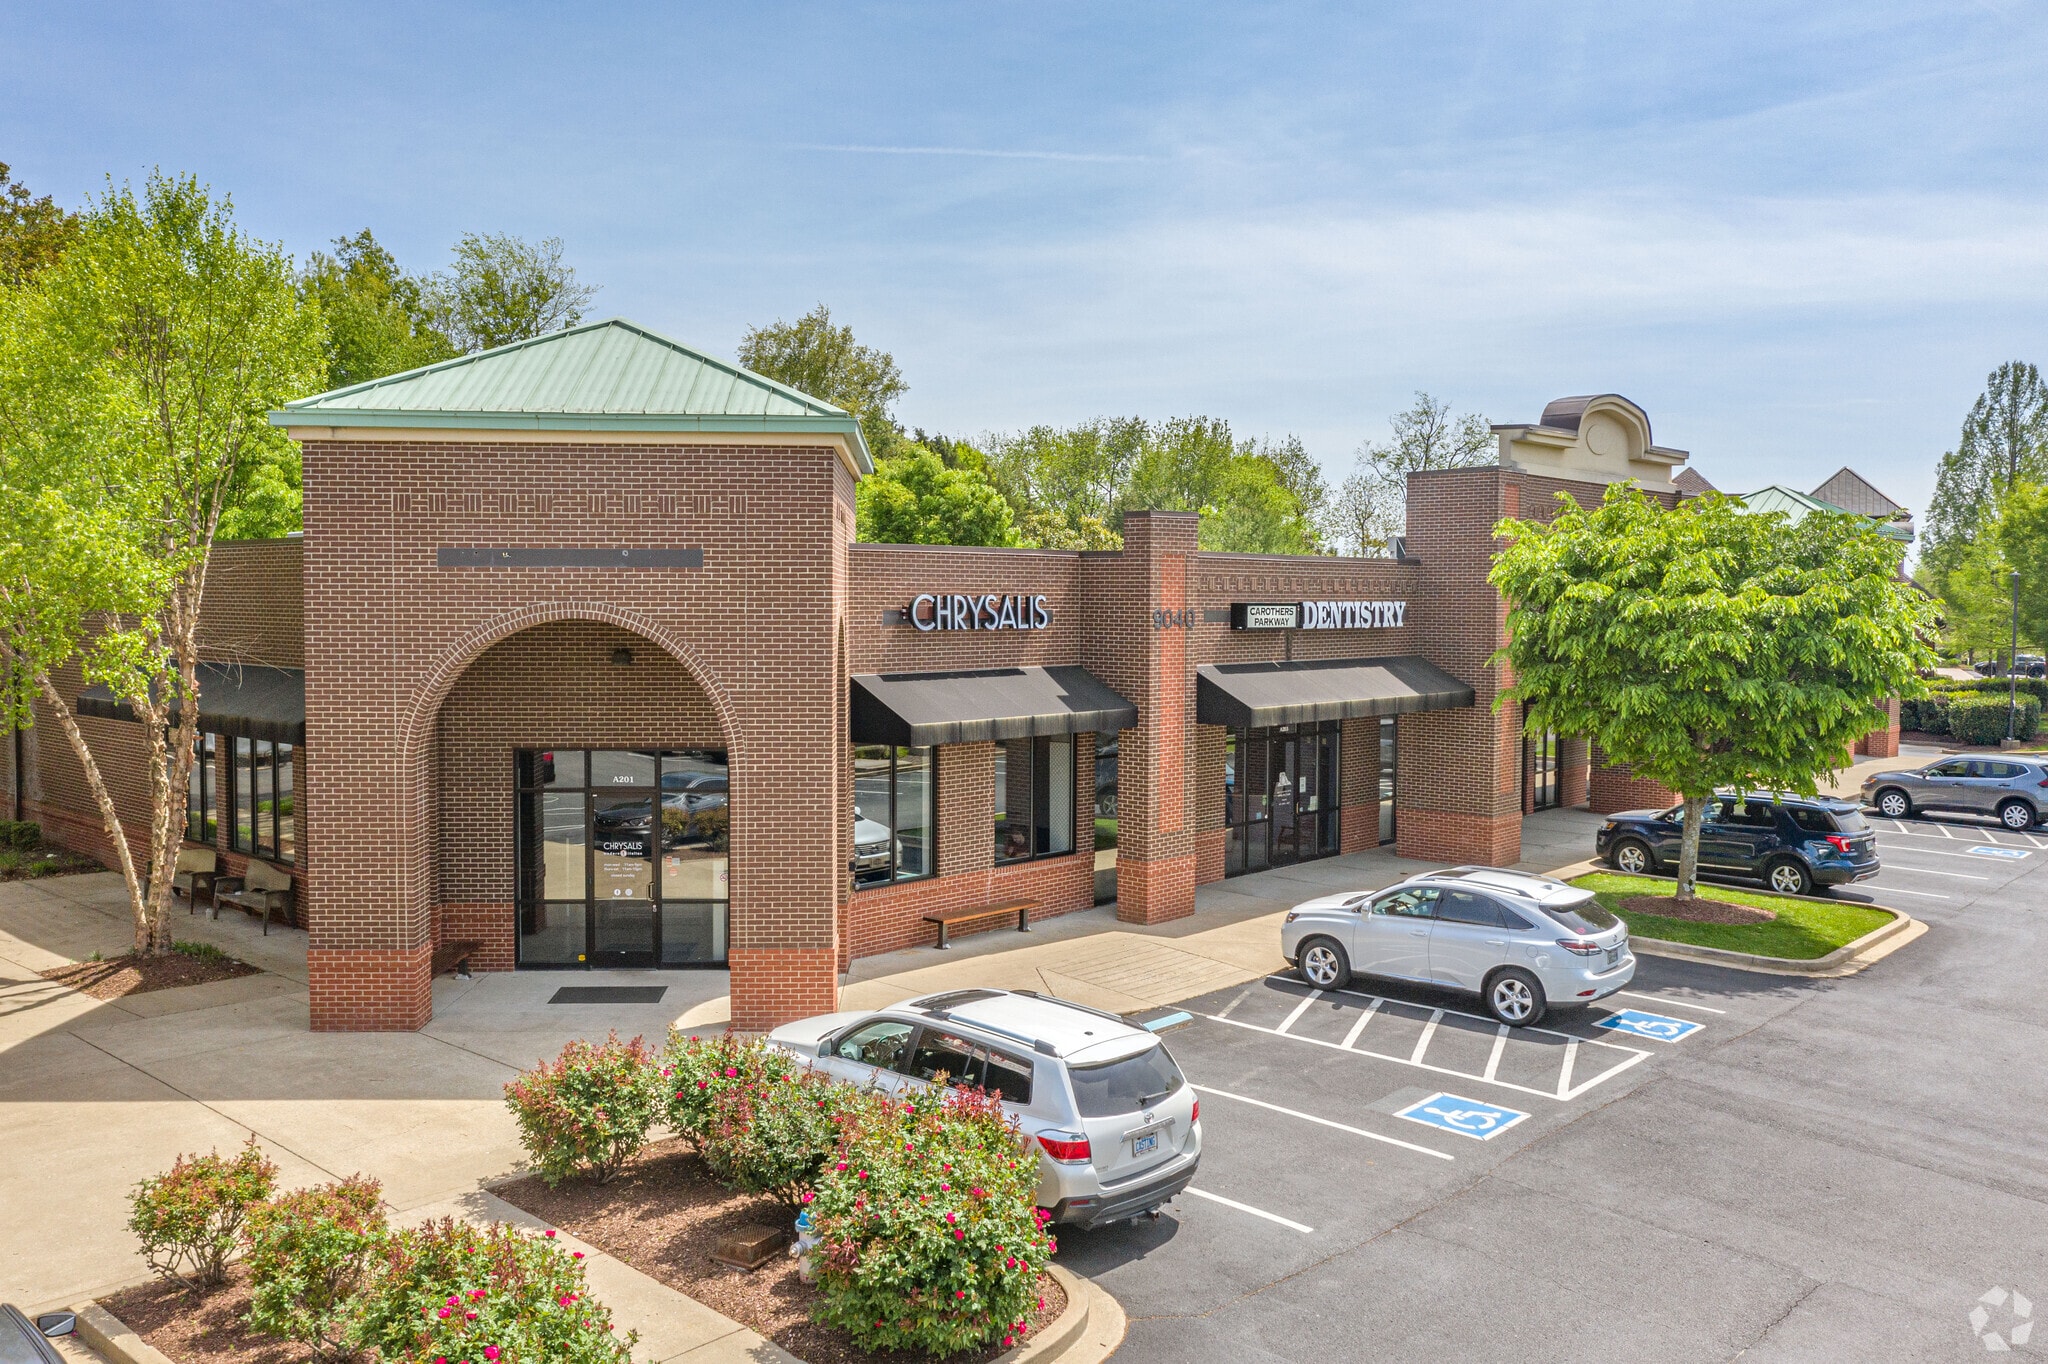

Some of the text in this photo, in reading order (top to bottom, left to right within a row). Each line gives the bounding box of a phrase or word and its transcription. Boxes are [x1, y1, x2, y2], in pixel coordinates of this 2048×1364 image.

[911, 593, 1048, 631] CHRYSALIS
[1250, 607, 1294, 616] CAROTHERS
[1303, 601, 1406, 629] DENTISTRY
[1153, 608, 1195, 629] 9040
[1254, 617, 1290, 627] PARKWAY
[612, 775, 634, 784] A201
[603, 841, 643, 850] CHRYSALIS
